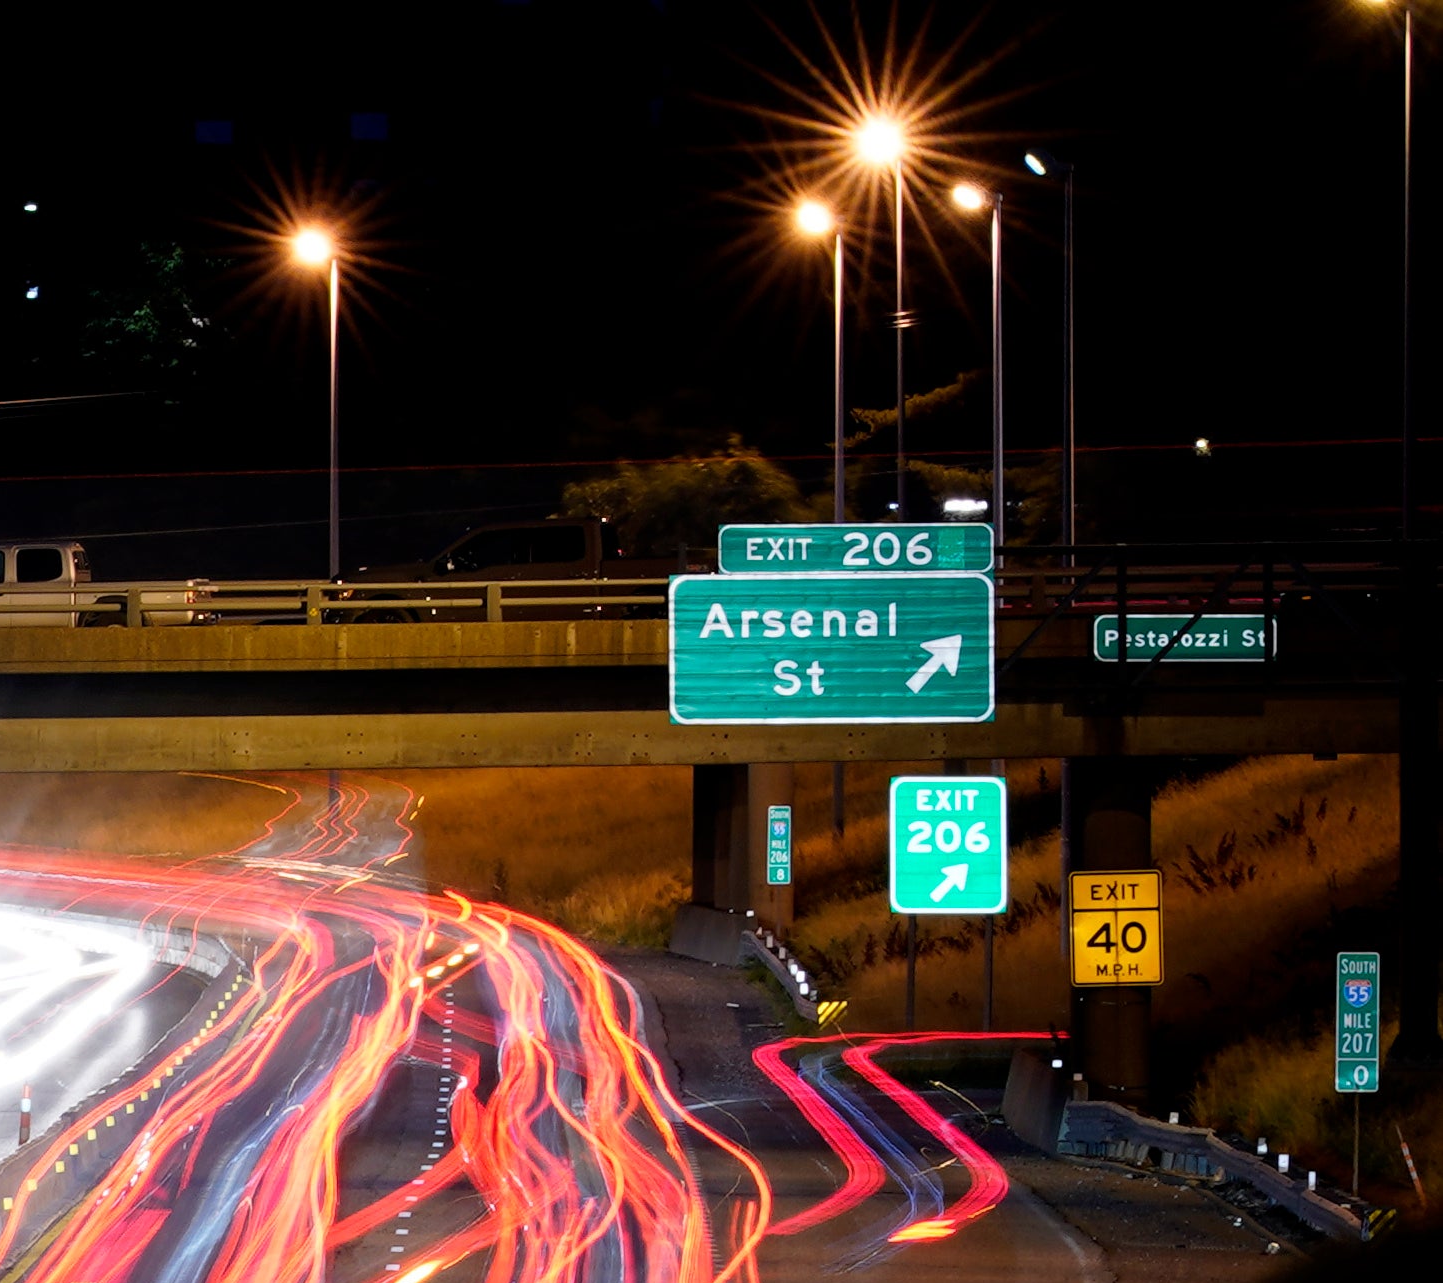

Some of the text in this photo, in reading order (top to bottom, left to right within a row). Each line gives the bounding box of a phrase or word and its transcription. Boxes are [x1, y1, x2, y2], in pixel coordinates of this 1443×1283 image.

[746, 531, 933, 566] EXIT 206
[699, 601, 897, 639] Arsenal
[1241, 629, 1266, 648] St
[773, 659, 825, 696] St
[916, 789, 979, 812] EXIT
[773, 824, 786, 836] 55
[906, 820, 991, 854] 206
[771, 839, 787, 850] MILE
[770, 850, 788, 864] 206
[1090, 884, 1140, 901] EXIT
[1086, 921, 1147, 954] 40
[1096, 964, 1143, 977] M.P.H.
[1341, 958, 1377, 975] SOUTH
[1348, 986, 1370, 1003] 55
[1343, 1013, 1372, 1029] MILE
[1341, 1033, 1374, 1054] 207
